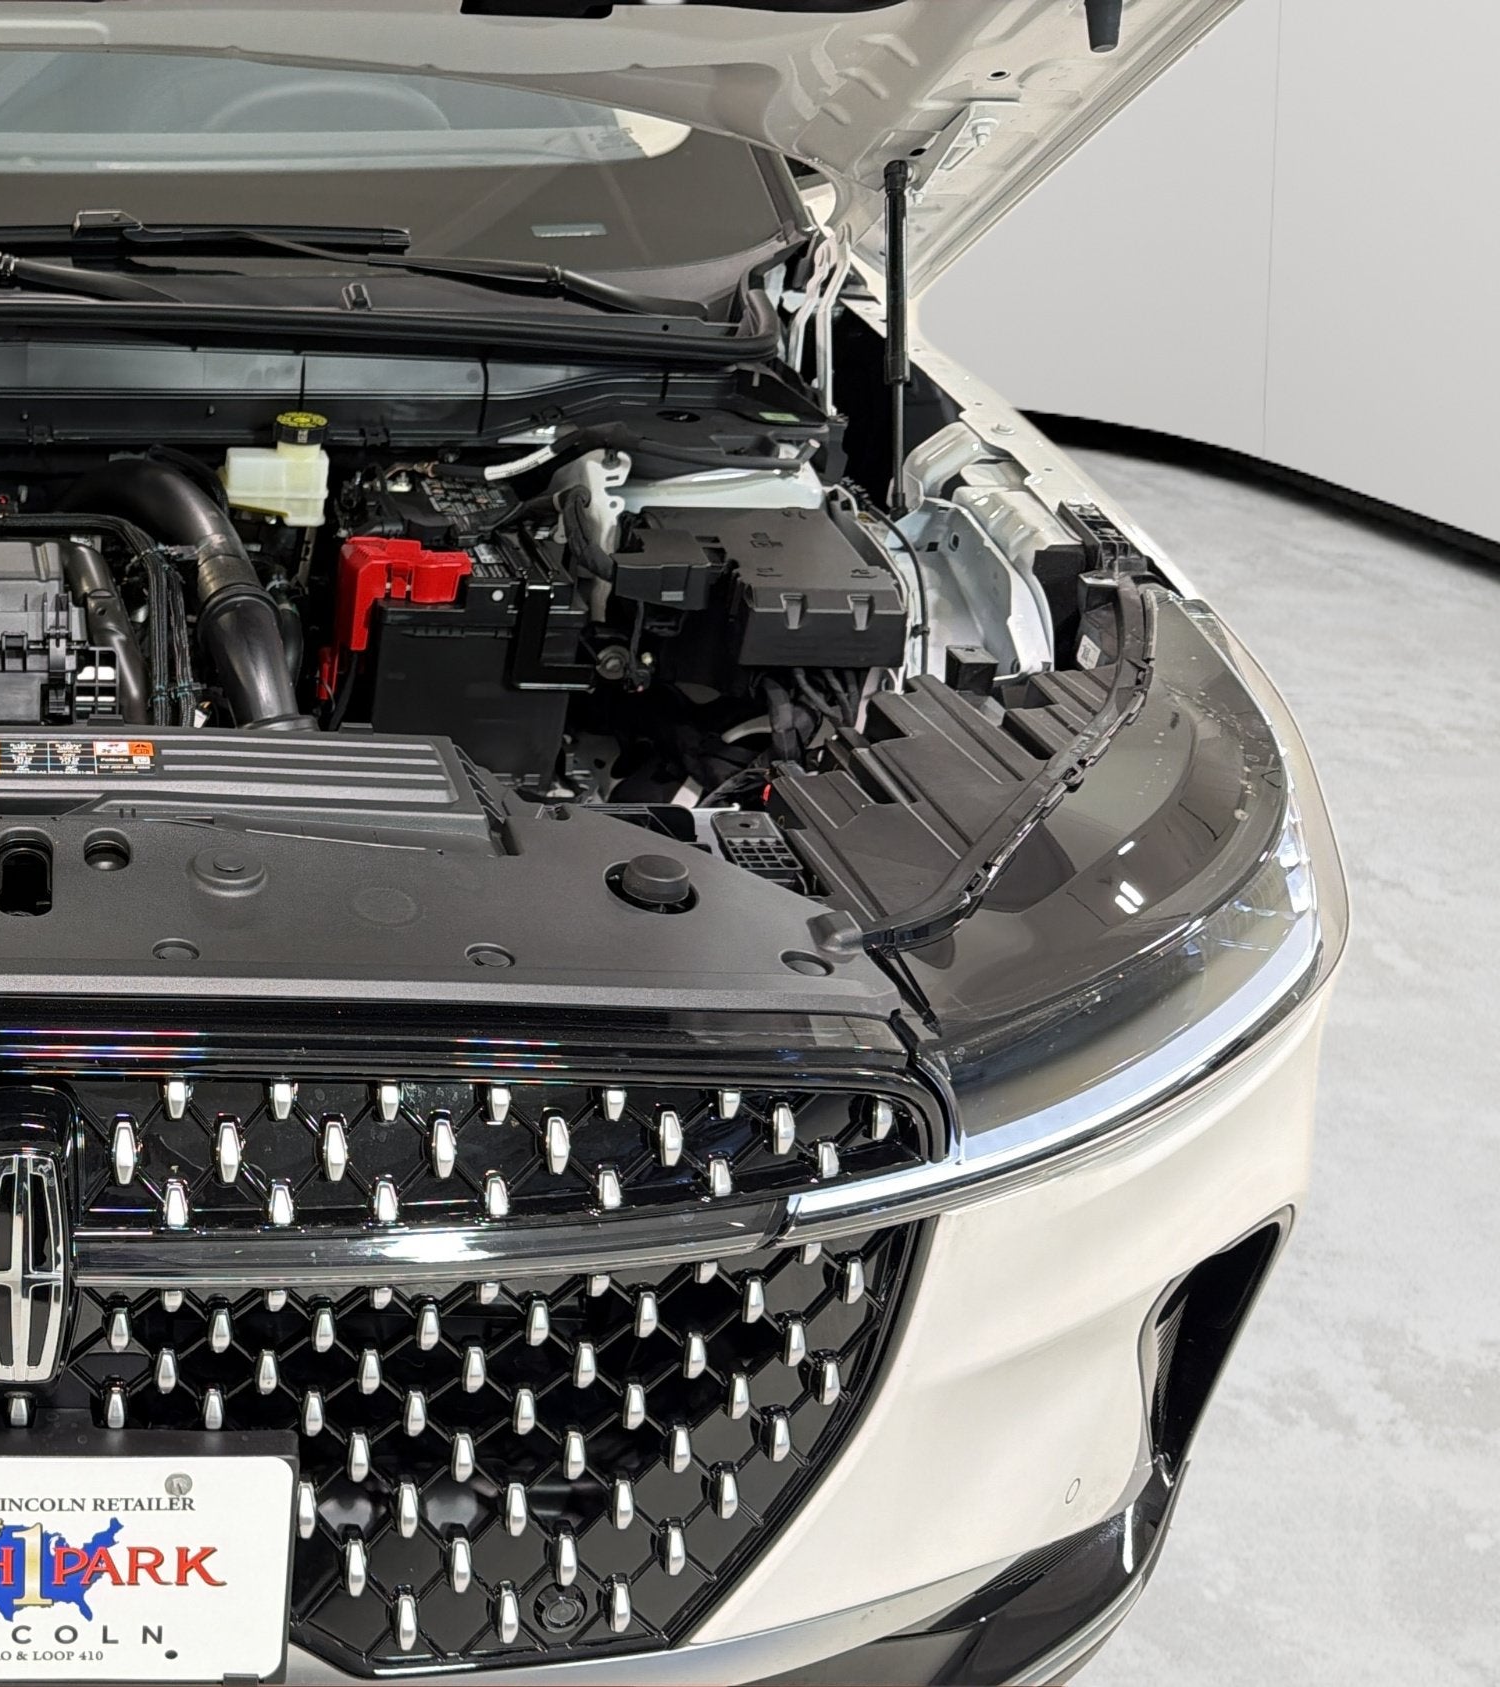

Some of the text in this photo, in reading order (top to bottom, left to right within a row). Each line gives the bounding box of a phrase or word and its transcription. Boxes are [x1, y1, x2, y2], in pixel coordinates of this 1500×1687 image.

[92, 1496, 197, 1512] RETAILER
[53, 1546, 228, 1587] PARK
[16, 1650, 29, 1661] &
[32, 1650, 75, 1662] LOOP
[78, 1650, 104, 1662] 410
